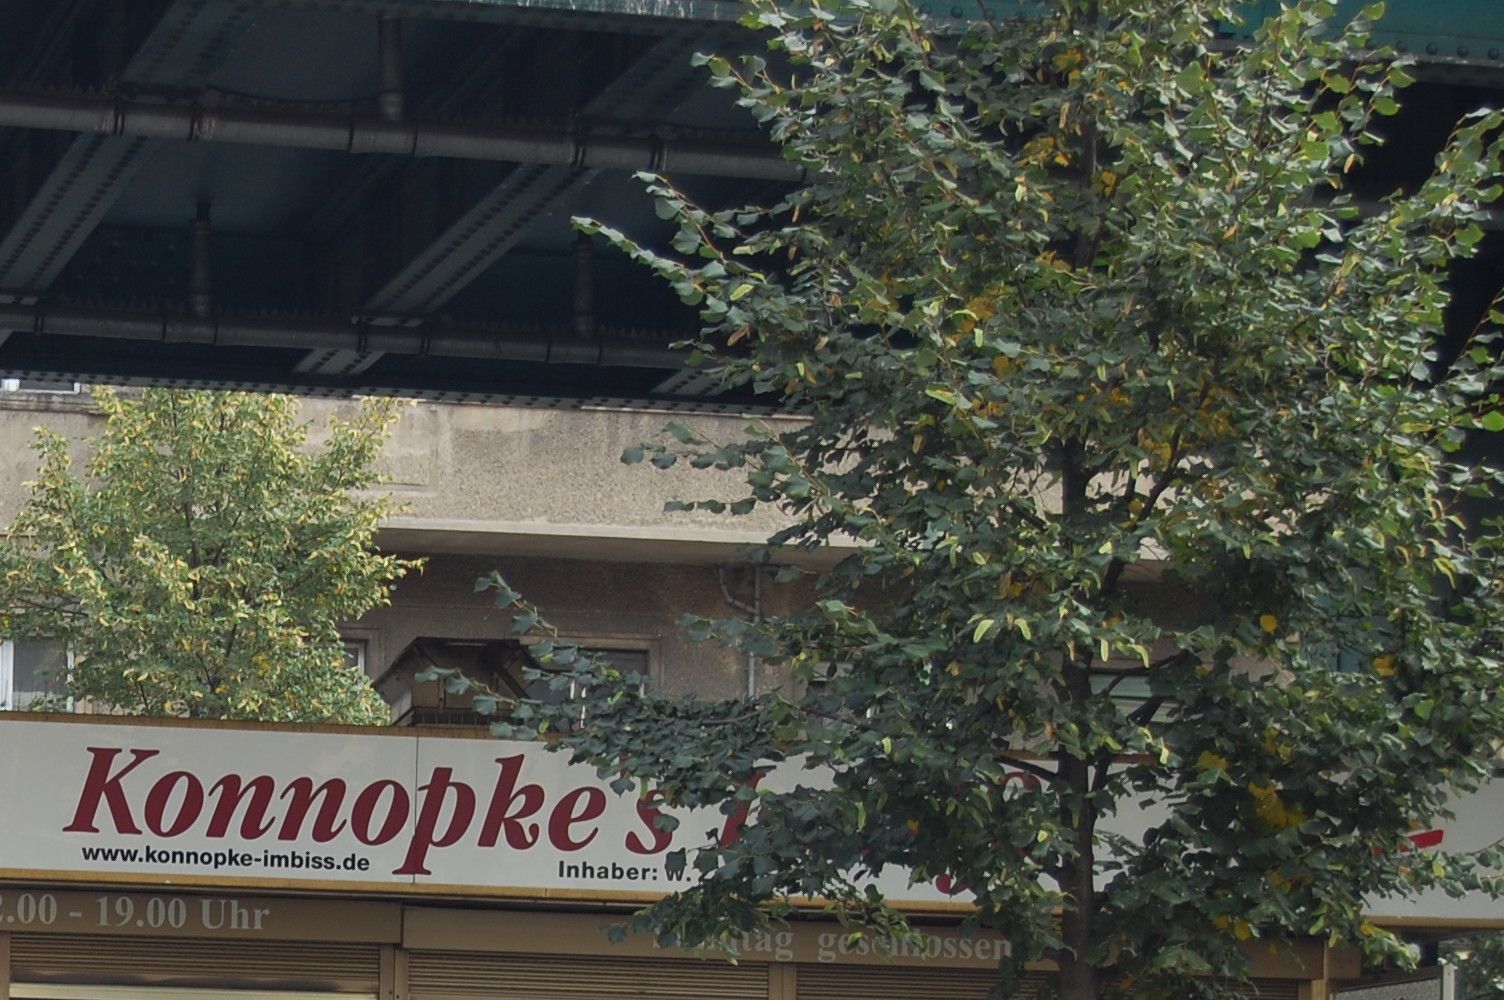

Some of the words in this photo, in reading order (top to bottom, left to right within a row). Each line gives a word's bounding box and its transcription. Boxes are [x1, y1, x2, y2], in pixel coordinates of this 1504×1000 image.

[82, 843, 371, 872] www.konnopke-imbiss.de
[558, 860, 658, 882] Inhaber:
[97, 895, 188, 930] 19.00
[200, 899, 270, 932] Uhr
